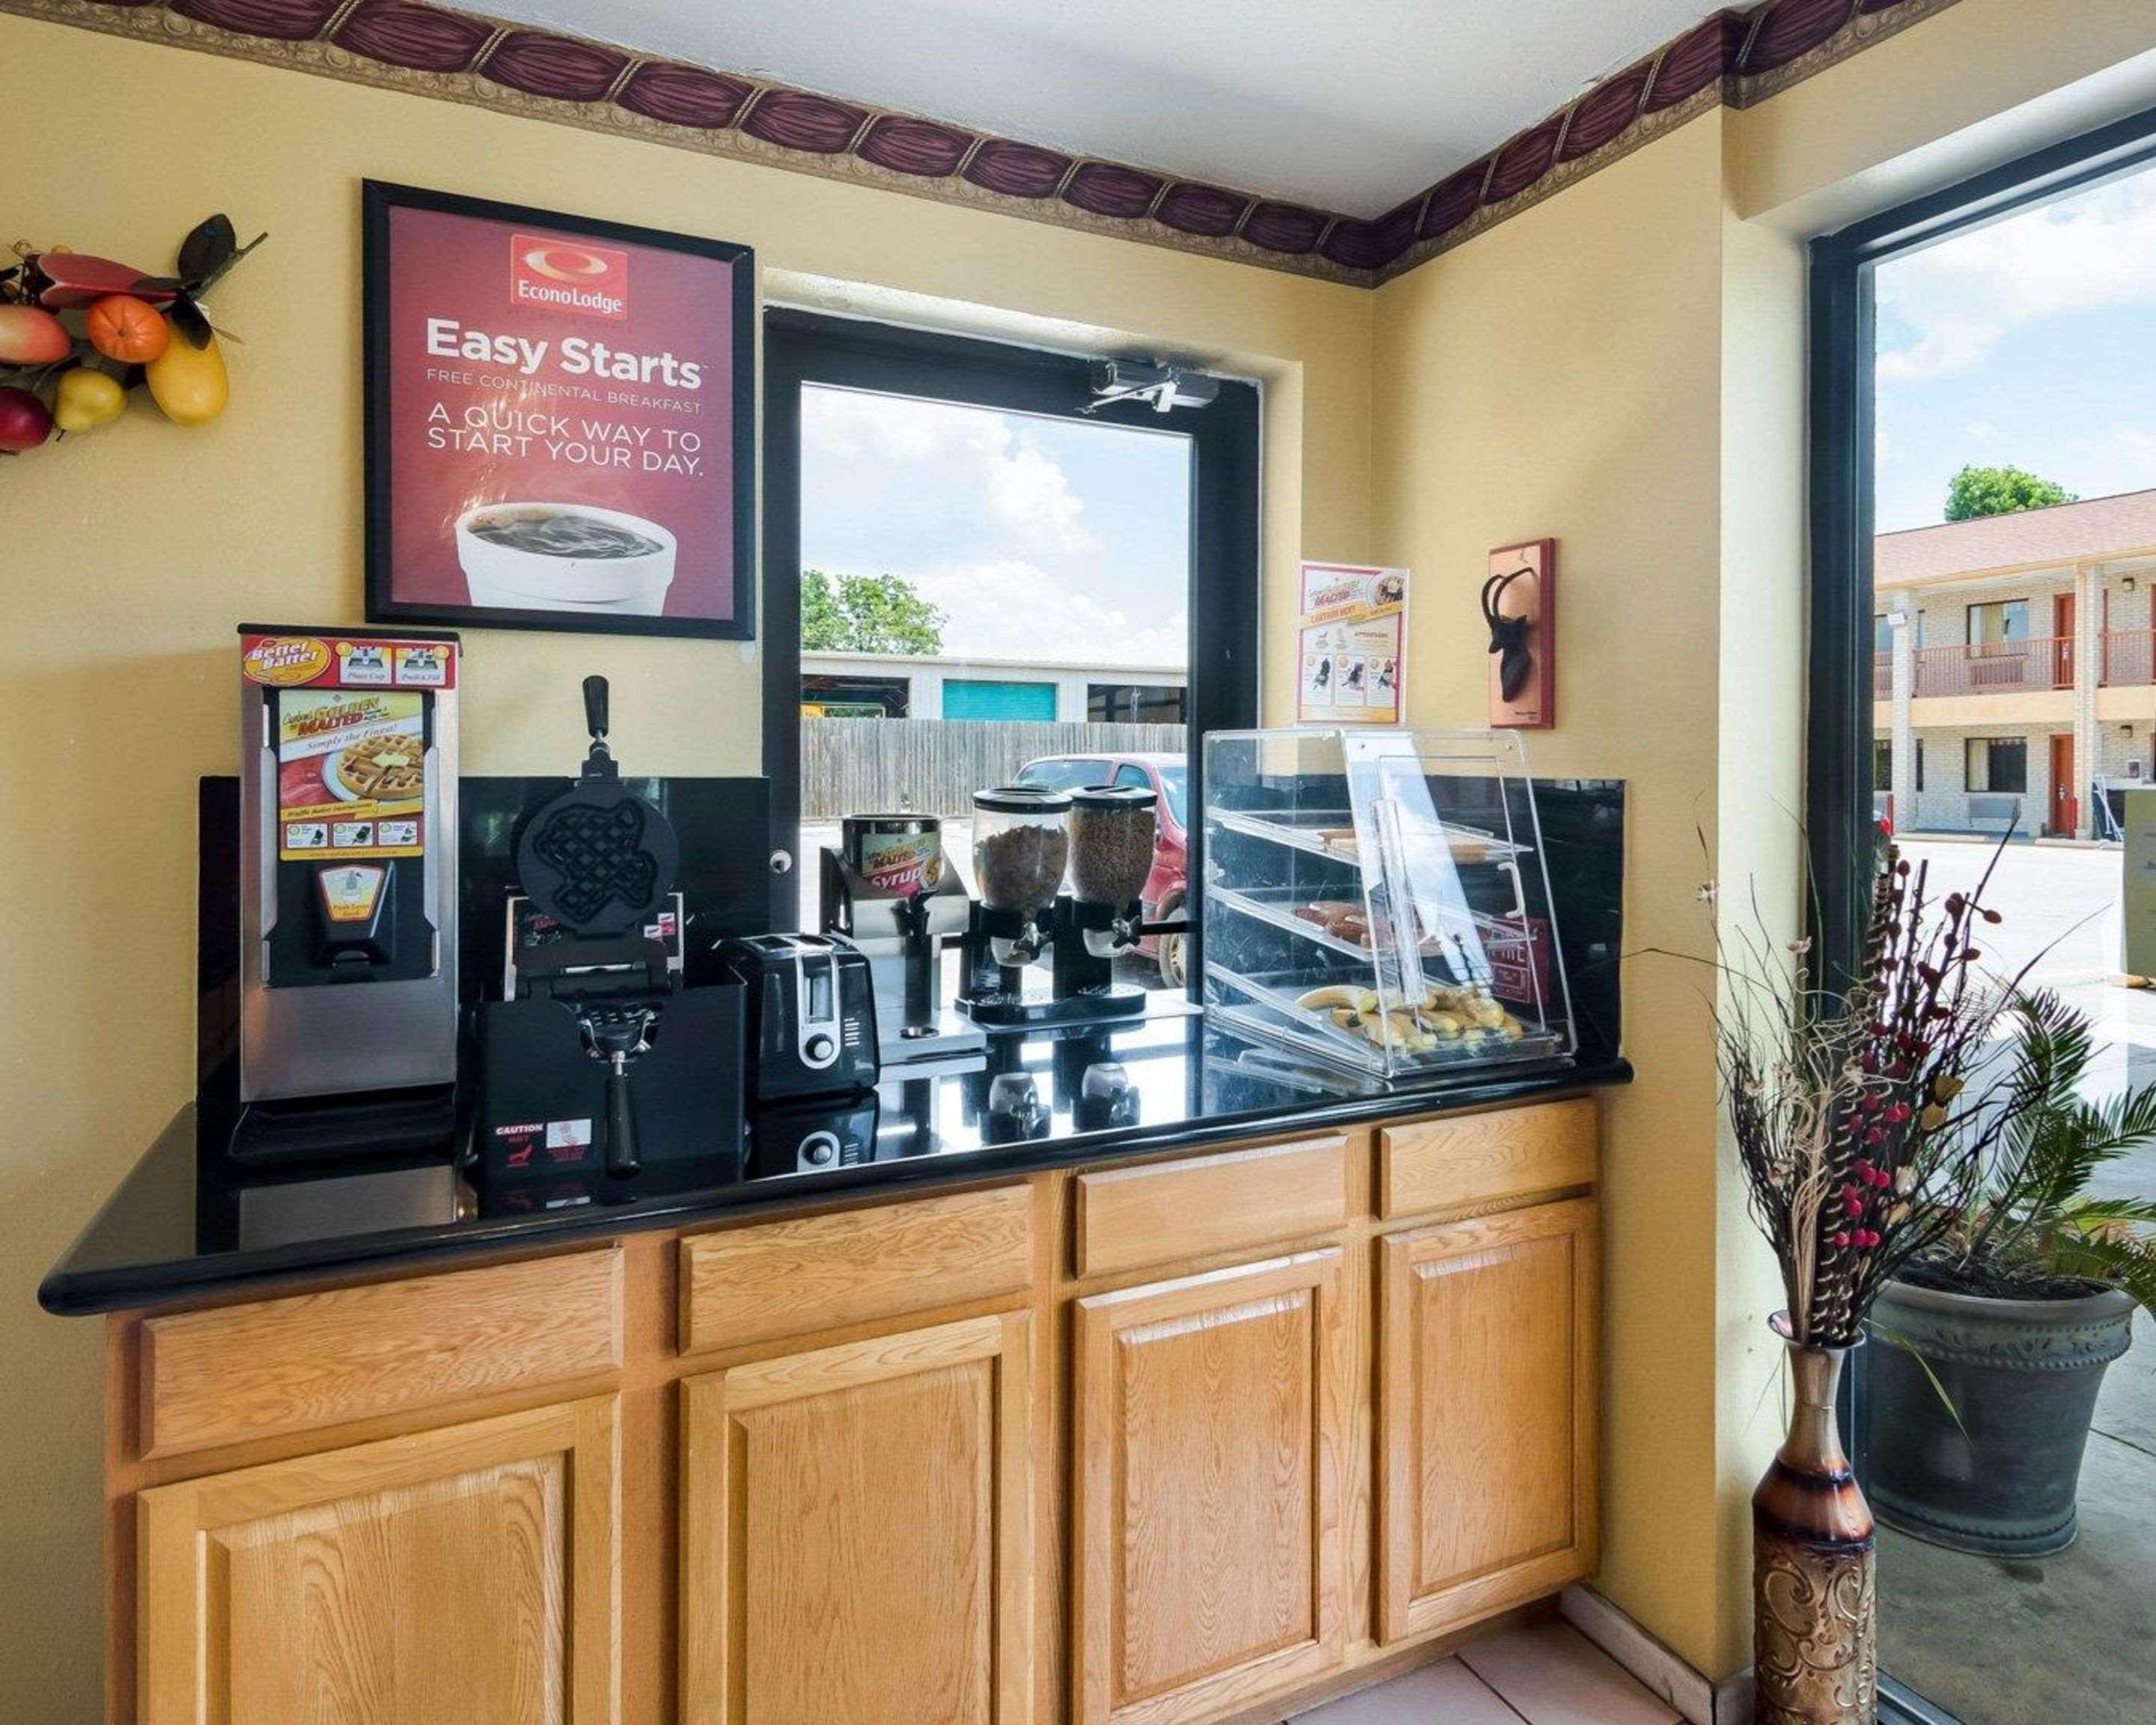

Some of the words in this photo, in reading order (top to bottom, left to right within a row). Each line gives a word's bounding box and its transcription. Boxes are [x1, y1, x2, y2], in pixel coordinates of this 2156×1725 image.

[518, 280, 622, 314] EconoLodge
[427, 317, 548, 374] Easy
[560, 337, 701, 389] Starts
[427, 368, 473, 384] FREE
[479, 375, 601, 401] CONTINENTAL
[608, 392, 701, 414] BREAKFAST
[427, 402, 451, 424] A
[465, 407, 570, 438] QUICK
[582, 419, 651, 446] WAY
[663, 430, 701, 453] TO
[427, 428, 532, 457] START
[545, 439, 631, 468] YOUR
[643, 451, 704, 477] DAY.
[297, 713, 363, 735] MALTED
[306, 737, 342, 751] Simply
[345, 733, 362, 742] the
[496, 1124, 543, 1135] CAUTION
